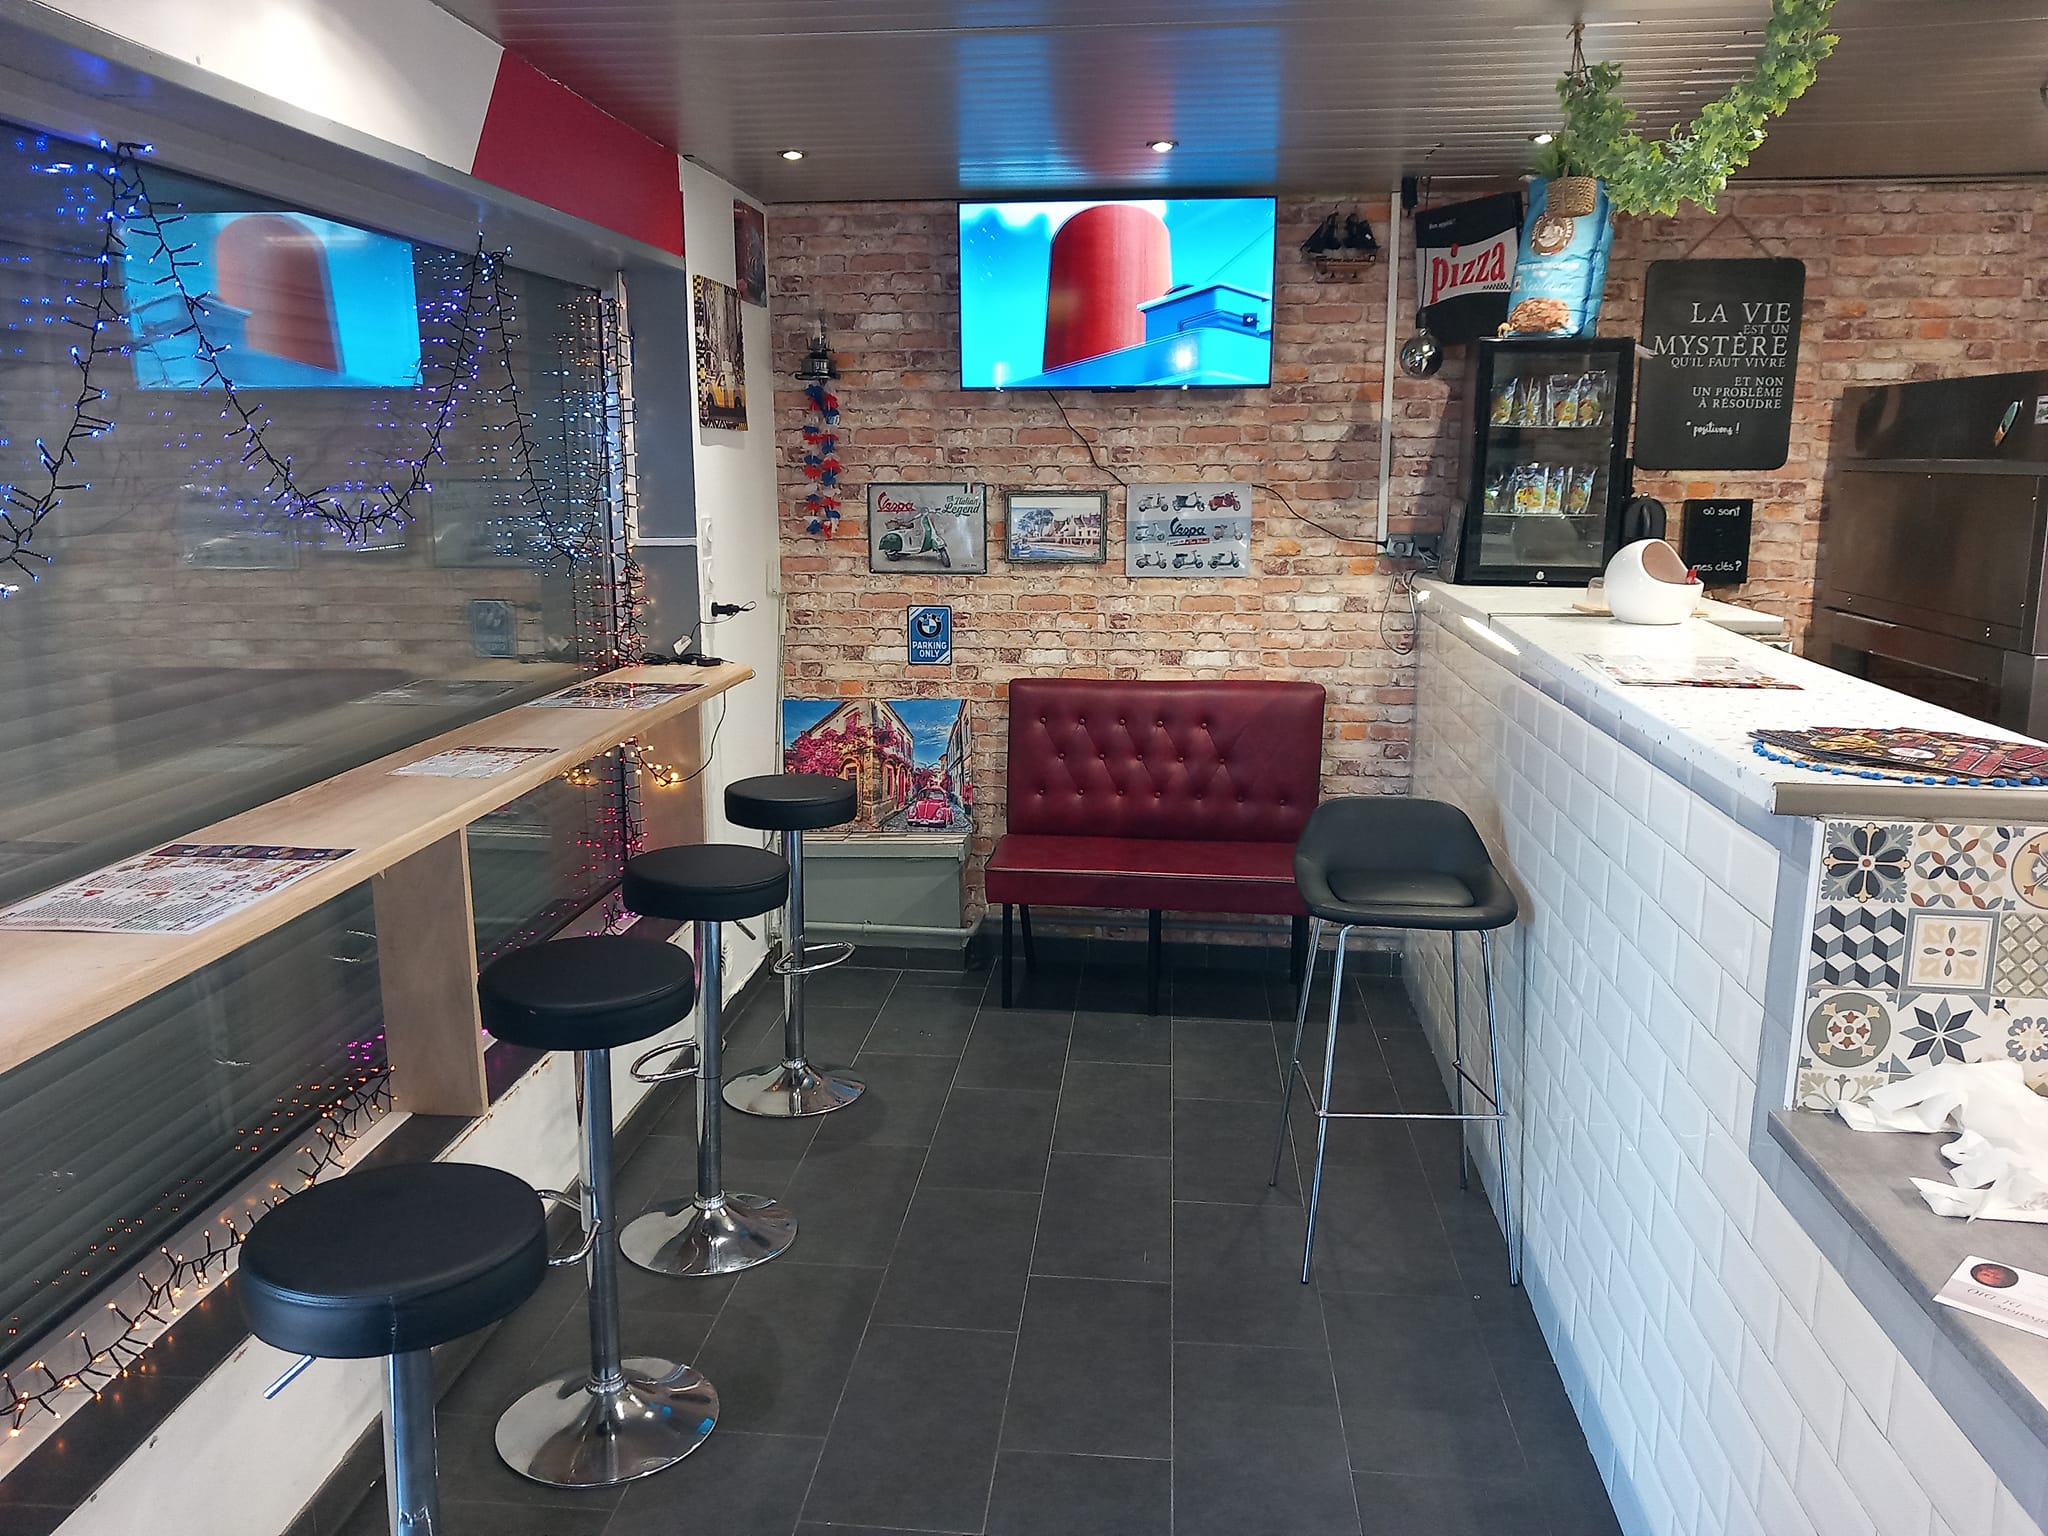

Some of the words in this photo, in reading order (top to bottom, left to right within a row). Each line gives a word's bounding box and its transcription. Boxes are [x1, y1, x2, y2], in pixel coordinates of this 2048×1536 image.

[1430, 241, 1506, 304] pizza
[1691, 303, 1729, 323] LA
[1743, 303, 1791, 323] VIE
[1744, 325, 1766, 334] EST
[1771, 325, 1789, 334] UN
[1654, 332, 1788, 356] MYSTÈRE
[1671, 358, 1703, 368] QU'IL
[1708, 358, 1739, 367] FAUT
[1745, 358, 1786, 367] VIVRE
[1735, 377, 1751, 386] ET
[1755, 377, 1784, 386] NON
[1692, 387, 1711, 397] UN
[1715, 386, 1783, 397] PROBLÈME
[1698, 397, 1707, 408] À
[1713, 398, 1782, 409] RÉSOUDRE
[877, 491, 917, 514] Vespa
[954, 496, 979, 506] Italian
[942, 502, 981, 517] Legend
[1718, 506, 1741, 517] sont
[1168, 517, 1207, 538] Vespa
[912, 641, 947, 650] PARKING
[919, 649, 940, 658] ONLY
